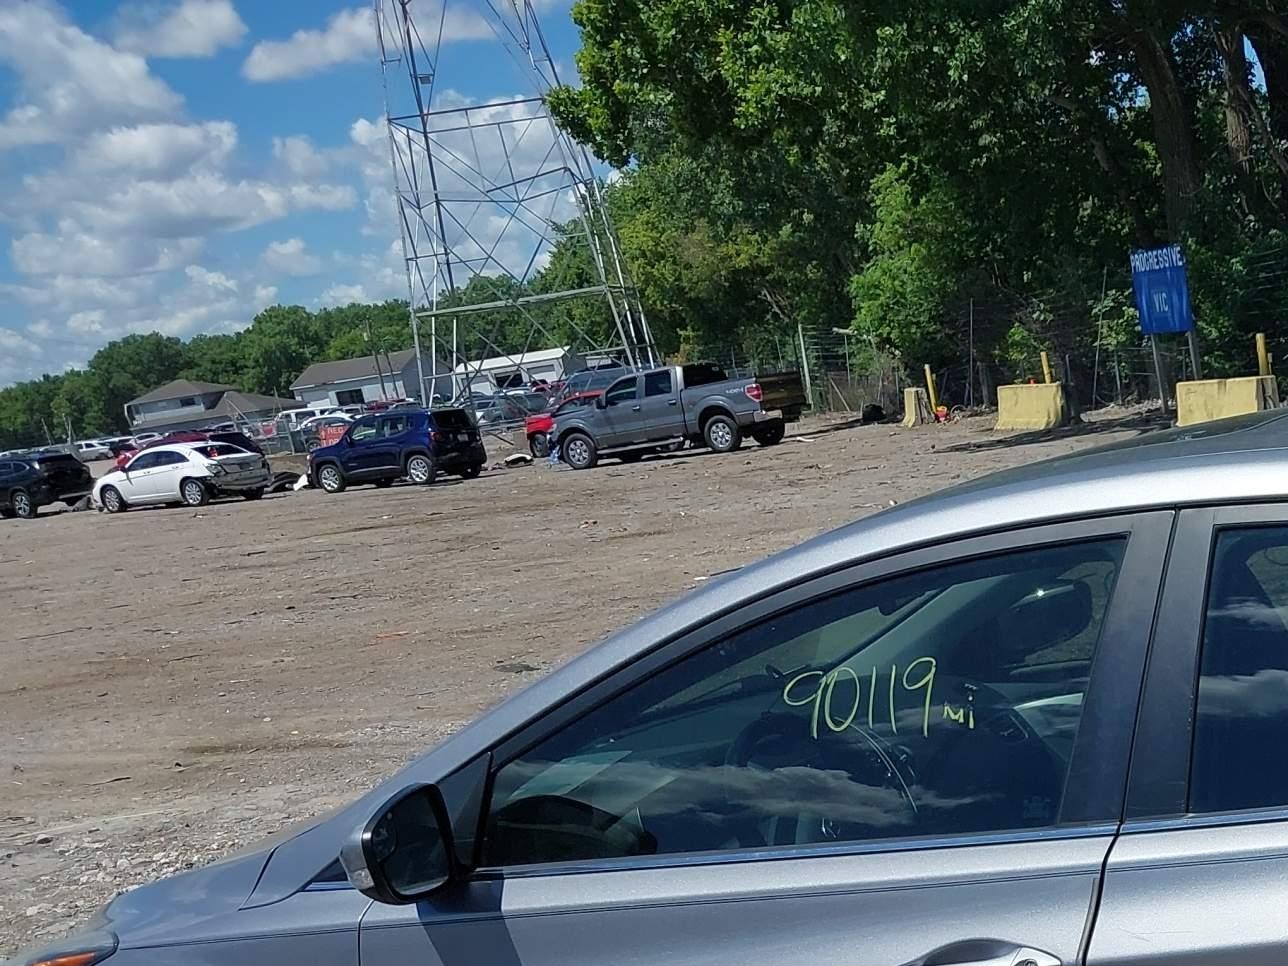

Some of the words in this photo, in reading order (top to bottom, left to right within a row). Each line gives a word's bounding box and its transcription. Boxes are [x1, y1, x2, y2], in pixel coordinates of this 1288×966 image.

[1130, 246, 1183, 273] PROGRESSIVE
[1153, 292, 1169, 312] VIC
[783, 656, 937, 740] 90119
